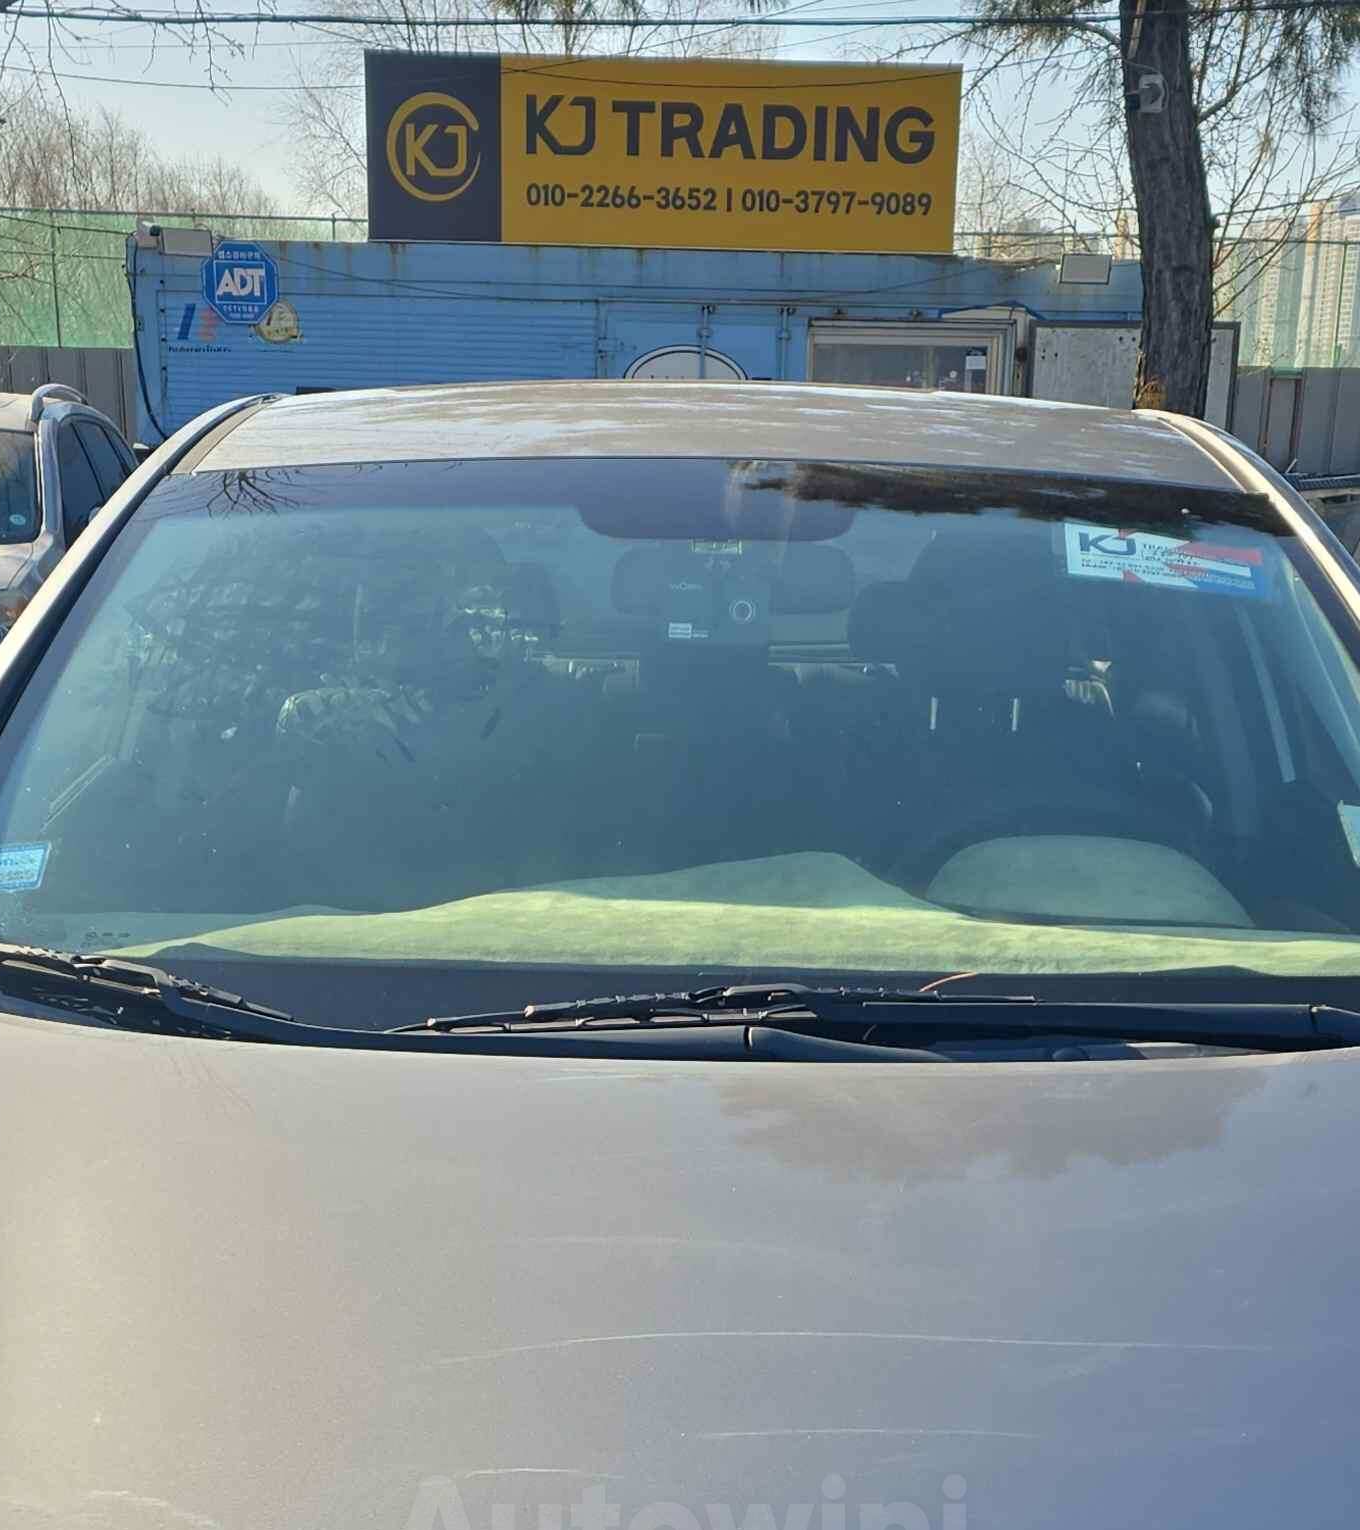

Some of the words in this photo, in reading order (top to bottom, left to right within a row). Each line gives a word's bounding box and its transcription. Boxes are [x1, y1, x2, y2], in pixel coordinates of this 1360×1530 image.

[525, 94, 597, 156] KJ
[612, 100, 935, 164] TRADING
[404, 122, 469, 178] KJ
[525, 183, 717, 212] 010-2266-3652
[741, 188, 932, 217] 010-3797-9089
[215, 267, 266, 297] ADT
[1078, 532, 1137, 556] KJ
